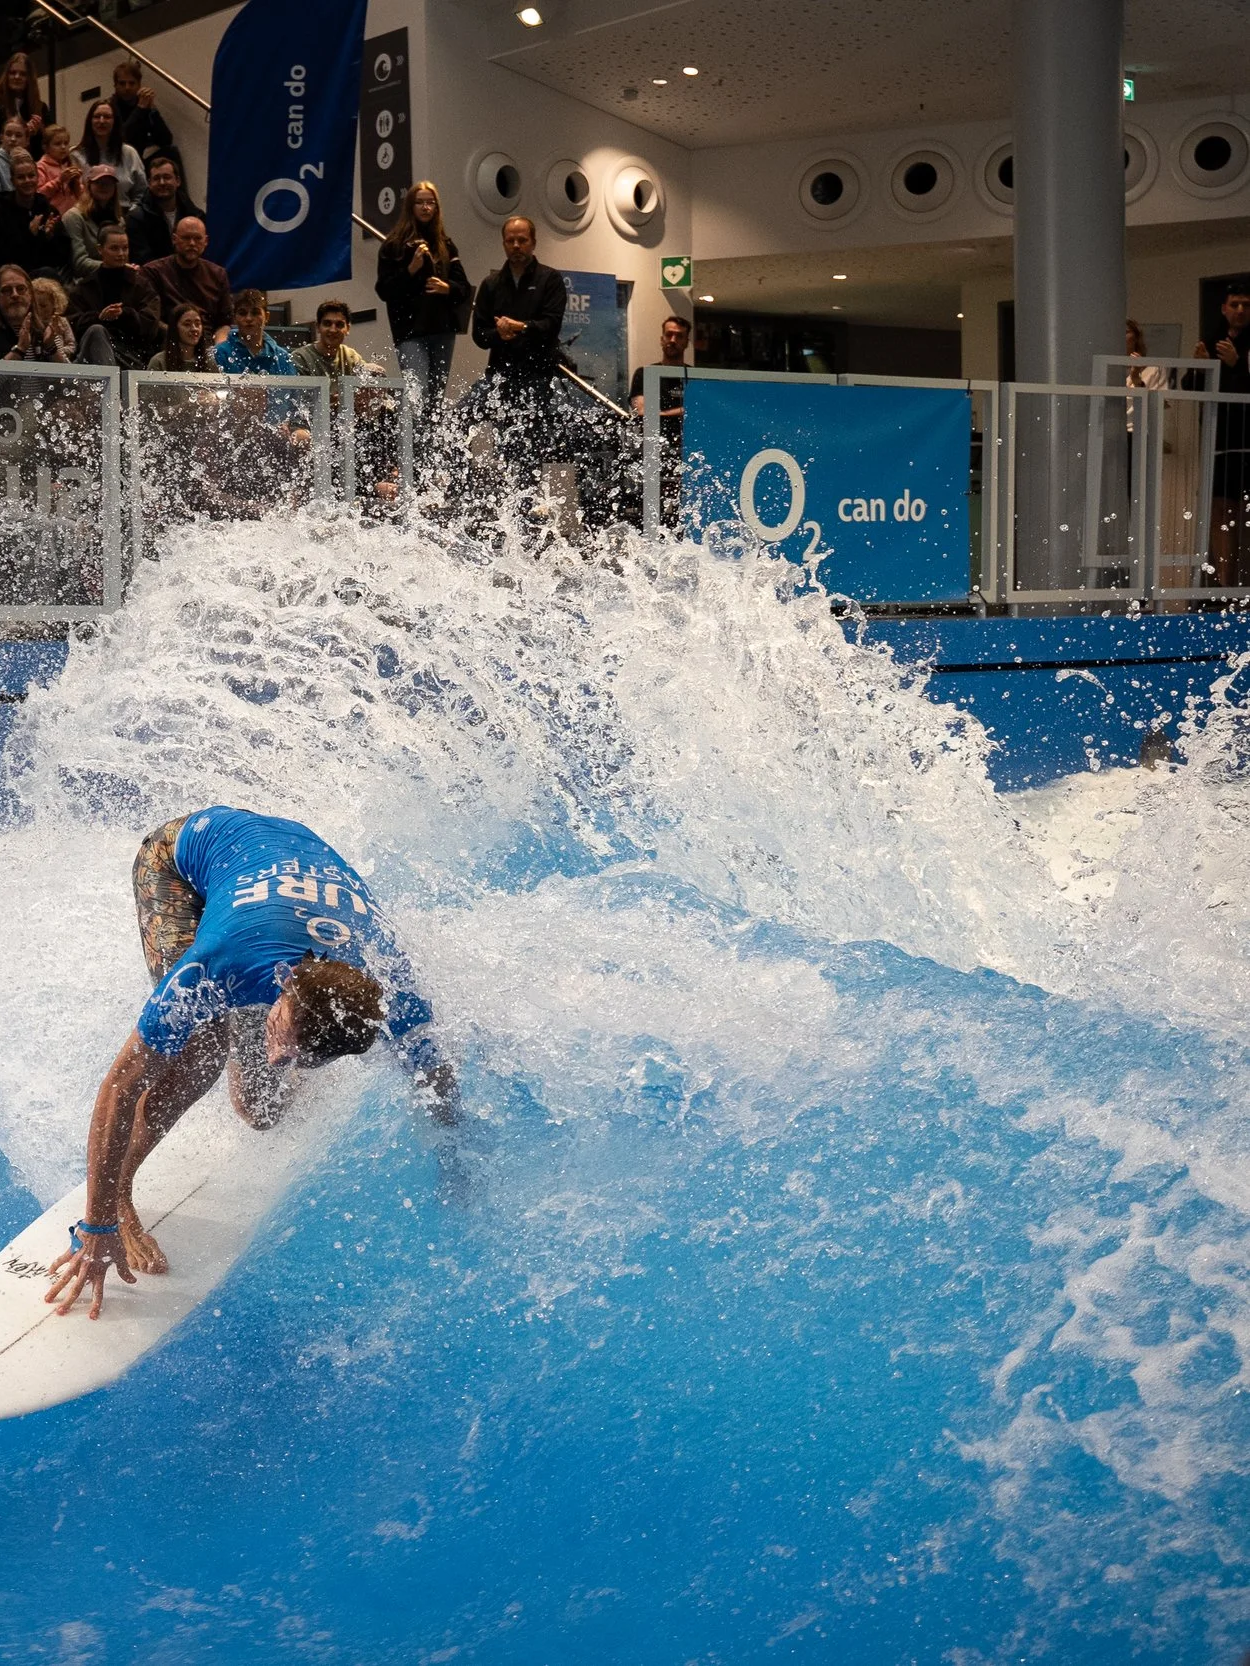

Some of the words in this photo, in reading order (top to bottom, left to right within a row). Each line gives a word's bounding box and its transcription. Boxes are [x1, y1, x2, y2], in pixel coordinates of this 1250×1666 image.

[284, 64, 306, 97] do
[287, 104, 304, 149] can
[254, 161, 324, 233] O2
[562, 312, 590, 324] STERS
[565, 294, 590, 311] RF
[838, 497, 885, 522] can
[893, 489, 926, 522] do
